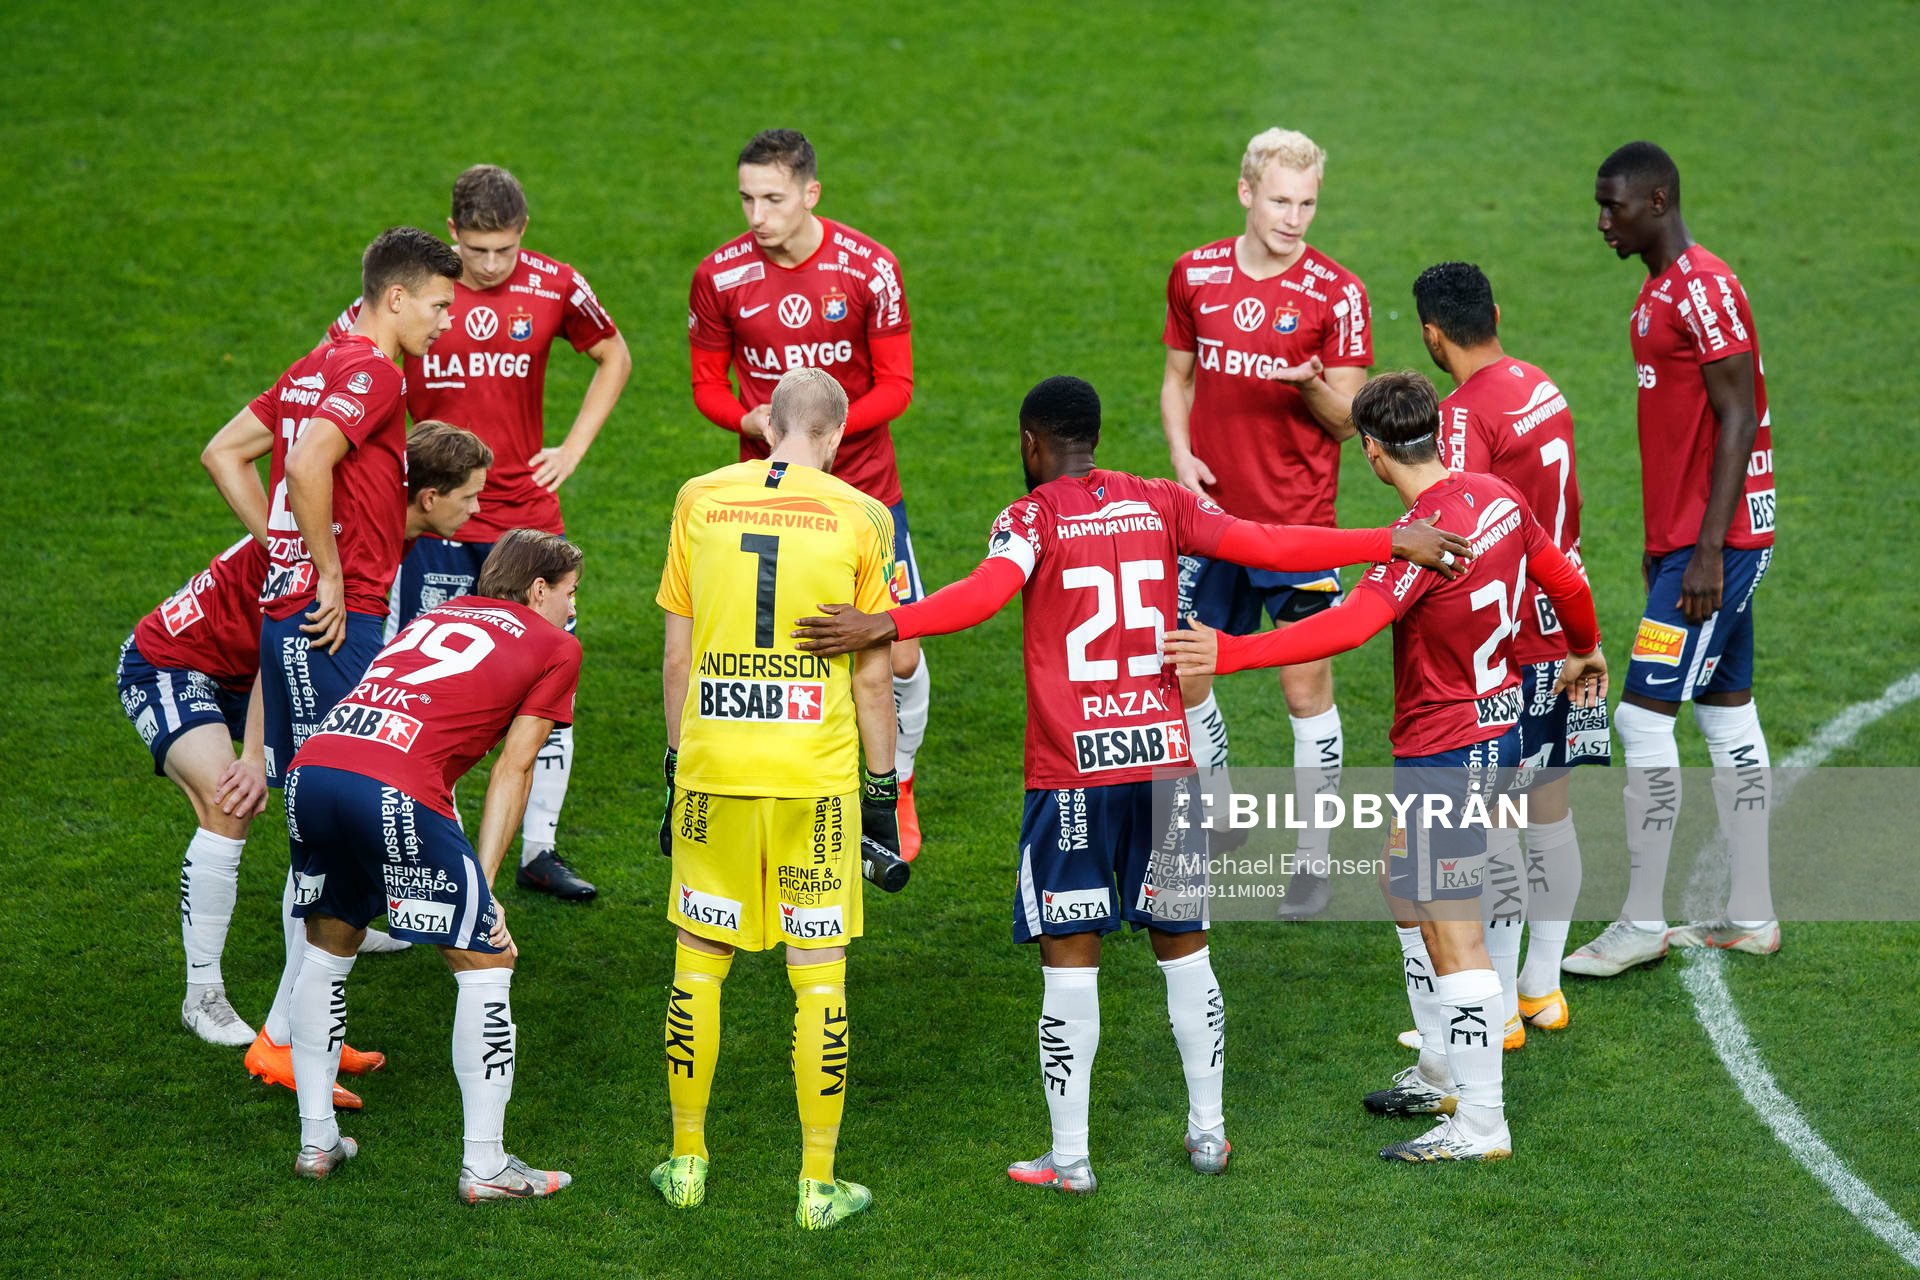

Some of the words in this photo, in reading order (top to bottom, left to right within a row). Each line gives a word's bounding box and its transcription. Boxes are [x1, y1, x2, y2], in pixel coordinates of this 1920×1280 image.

[714, 241, 752, 264] BJELIN
[833, 232, 872, 259] BJELIN
[1192, 247, 1231, 260] BJELIN
[423, 352, 465, 378] H.A
[469, 352, 531, 378] BYGG
[744, 346, 781, 370] H.A
[785, 340, 852, 368] BYGG
[328, 396, 361, 417] UNIBET
[706, 510, 838, 533] HAMMARVIKEN
[1751, 494, 1775, 530] BES
[740, 533, 780, 648] 1
[1062, 559, 1165, 682] 25
[360, 617, 496, 685] 29
[699, 651, 830, 678] ANDERSSON
[283, 637, 304, 717] Månsson
[700, 682, 783, 719] BESAB
[1567, 706, 1607, 724] RICAR
[317, 706, 383, 737] ESAB
[1076, 727, 1165, 769] BESAB
[1570, 741, 1610, 760] RAST
[1315, 736, 1340, 812] MIK
[1729, 744, 1765, 812] MIKE
[1641, 767, 1676, 832] MIKE
[381, 786, 402, 863] Månsson
[694, 793, 708, 844] Månss
[1058, 789, 1070, 852] Semré
[382, 864, 431, 879] REINE
[437, 870, 448, 881] &
[384, 875, 458, 893] RICARDO
[778, 866, 819, 879] REINE
[824, 868, 833, 879] &
[779, 878, 842, 892] RICARDO
[1443, 864, 1486, 889] RAST
[386, 885, 436, 900] INVEST
[780, 890, 823, 905] INVEST
[1488, 852, 1522, 929] MIKE
[390, 908, 449, 932] RASTA
[683, 899, 738, 930] RASTA
[1045, 901, 1109, 922] RASTA
[784, 916, 843, 938] RASTA
[483, 1001, 513, 1080] MIKE
[666, 985, 694, 1078] MIKE
[820, 1007, 848, 1096] MIKE
[1040, 1014, 1074, 1096] MIKE
